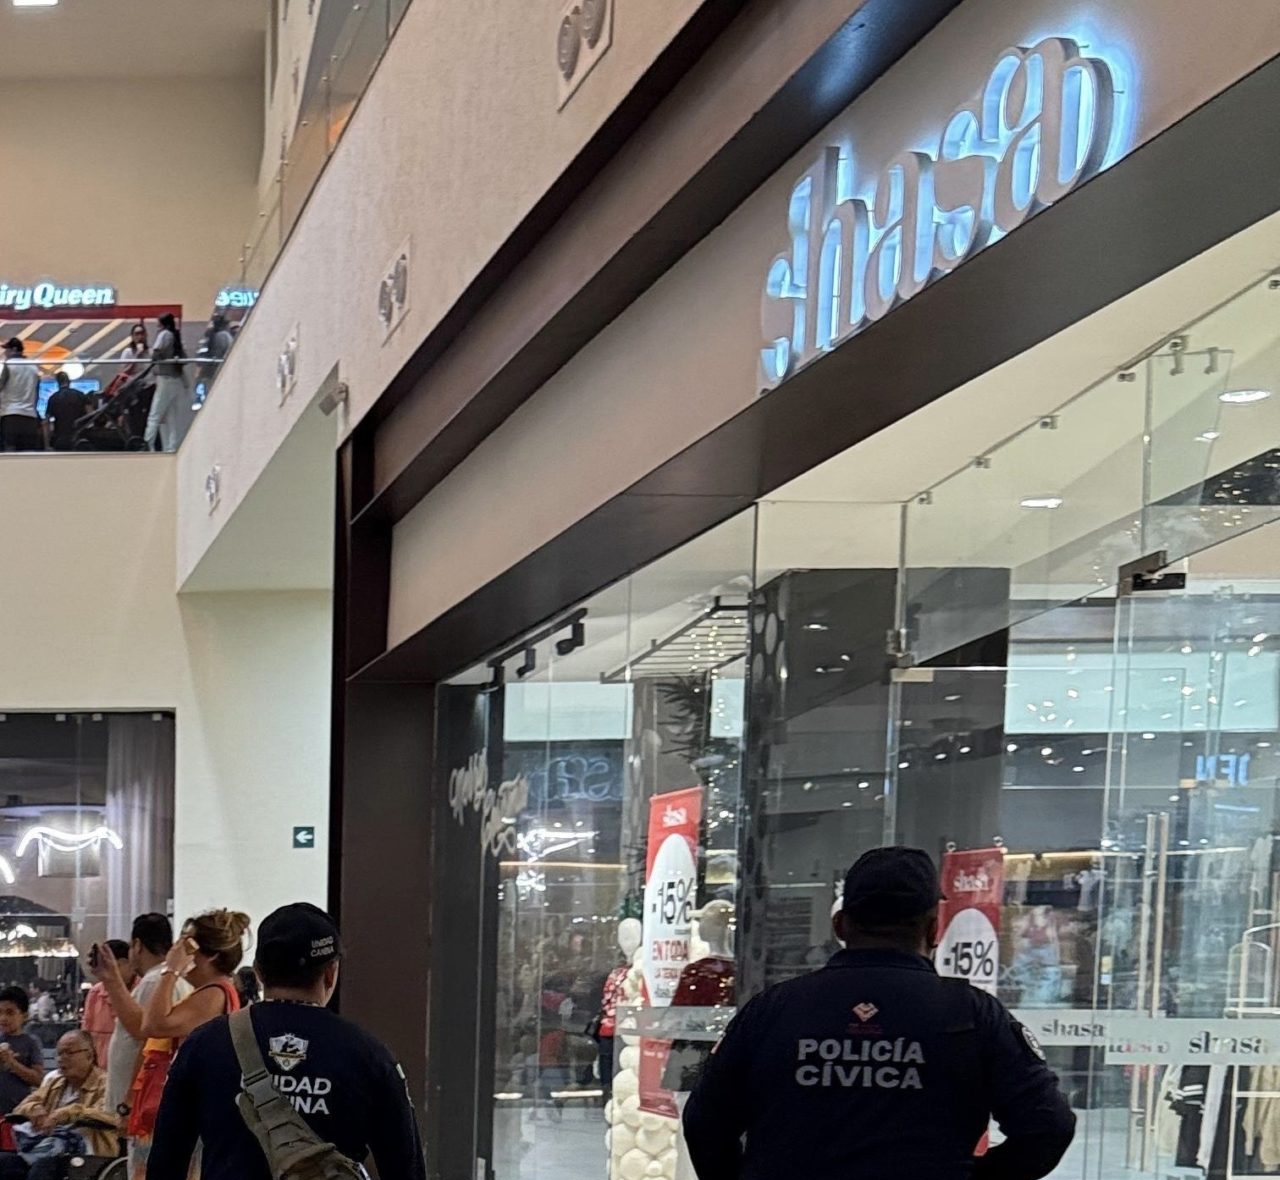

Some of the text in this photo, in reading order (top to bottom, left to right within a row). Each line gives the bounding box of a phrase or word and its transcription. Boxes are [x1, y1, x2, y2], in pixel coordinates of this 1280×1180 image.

[758, 37, 1114, 396] shasa
[33, 283, 115, 308] Queen
[652, 876, 693, 925] -15%
[943, 940, 994, 977] -15%
[1042, 1018, 1105, 1037] shasa
[797, 1037, 926, 1064] POLICÍA
[795, 1061, 923, 1089] CÍVICA
